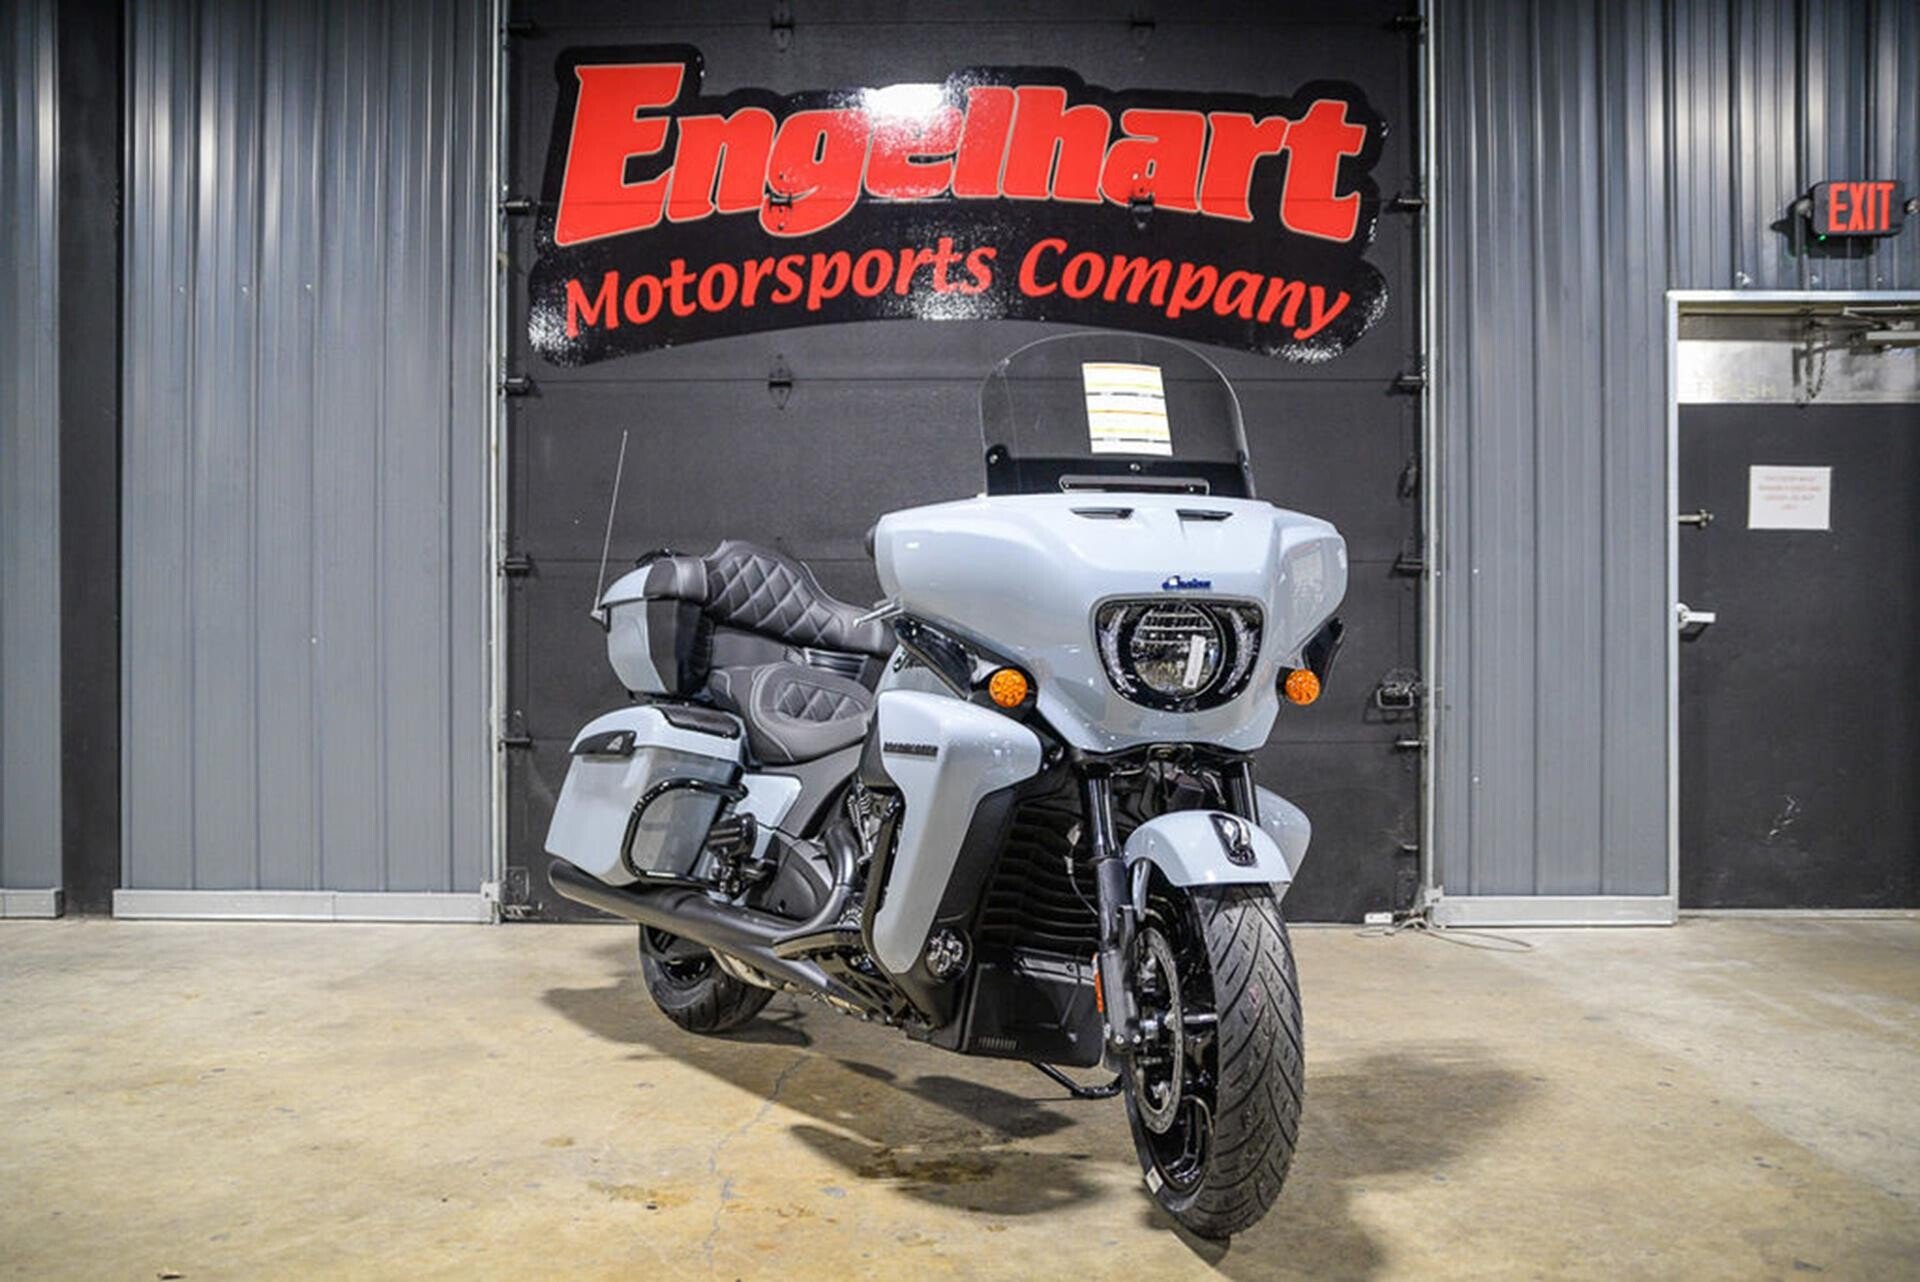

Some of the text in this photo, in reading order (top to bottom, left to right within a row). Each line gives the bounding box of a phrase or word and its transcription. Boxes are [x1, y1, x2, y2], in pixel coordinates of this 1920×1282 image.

[555, 63, 1367, 246] Engelhart
[1828, 182, 1895, 232] EXIT
[566, 236, 1351, 341] Motorsports Company
